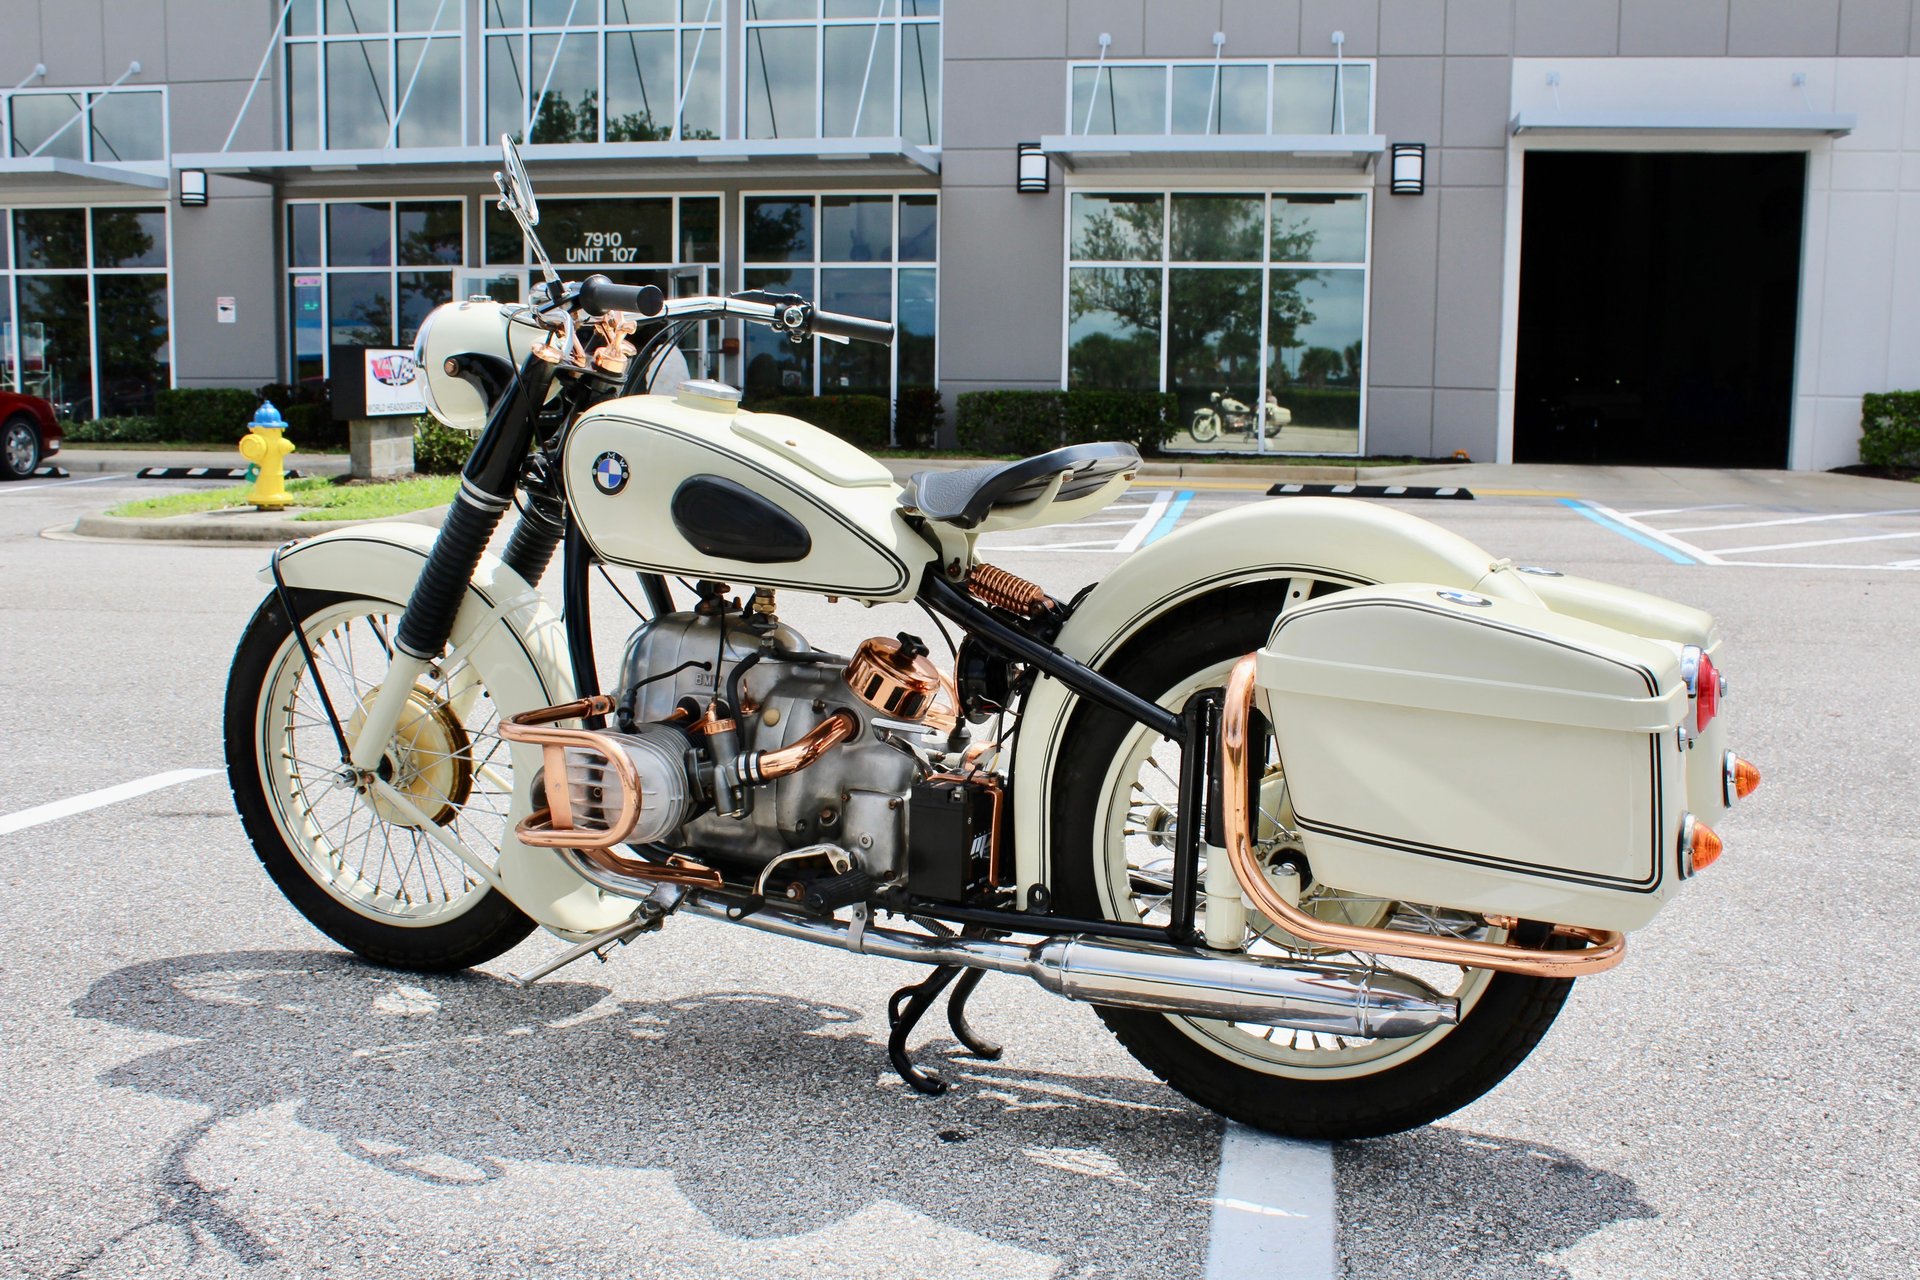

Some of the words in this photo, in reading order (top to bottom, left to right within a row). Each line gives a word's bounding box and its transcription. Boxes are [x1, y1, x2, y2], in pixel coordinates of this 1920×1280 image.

[583, 232, 622, 247] 7910
[566, 247, 604, 262] UNIT
[610, 247, 637, 262] 107
